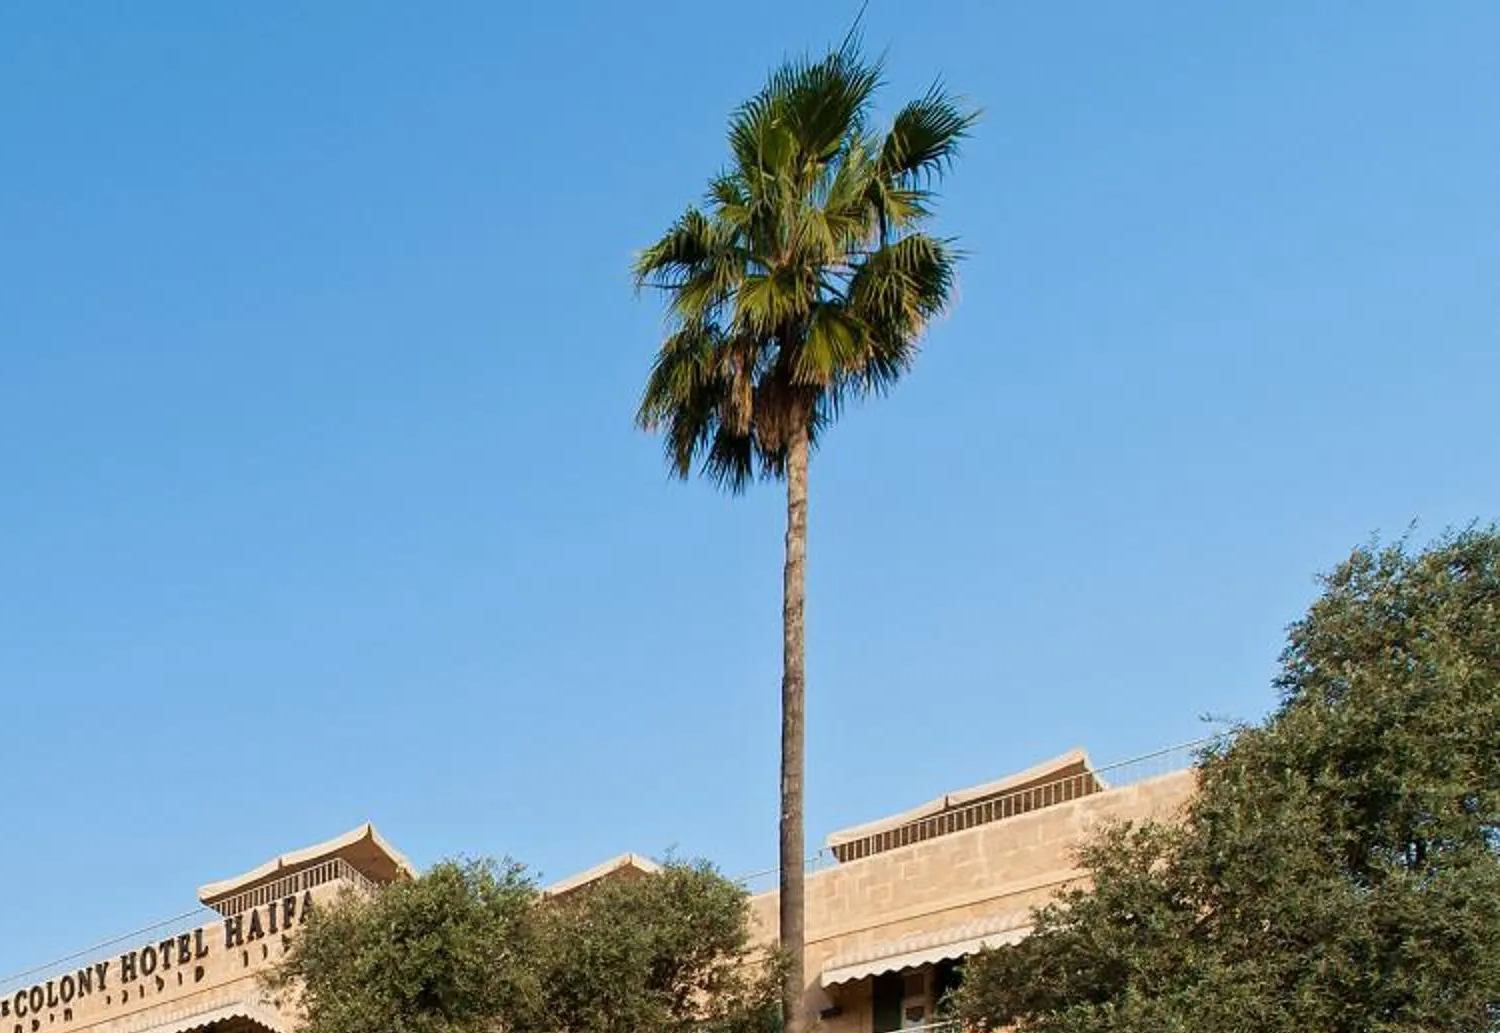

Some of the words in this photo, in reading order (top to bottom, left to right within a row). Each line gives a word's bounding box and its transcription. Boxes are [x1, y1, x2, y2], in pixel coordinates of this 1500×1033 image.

[13, 961, 110, 1019] COLONY
[119, 927, 209, 985] HOTEL
[224, 889, 315, 950] HAIFA
